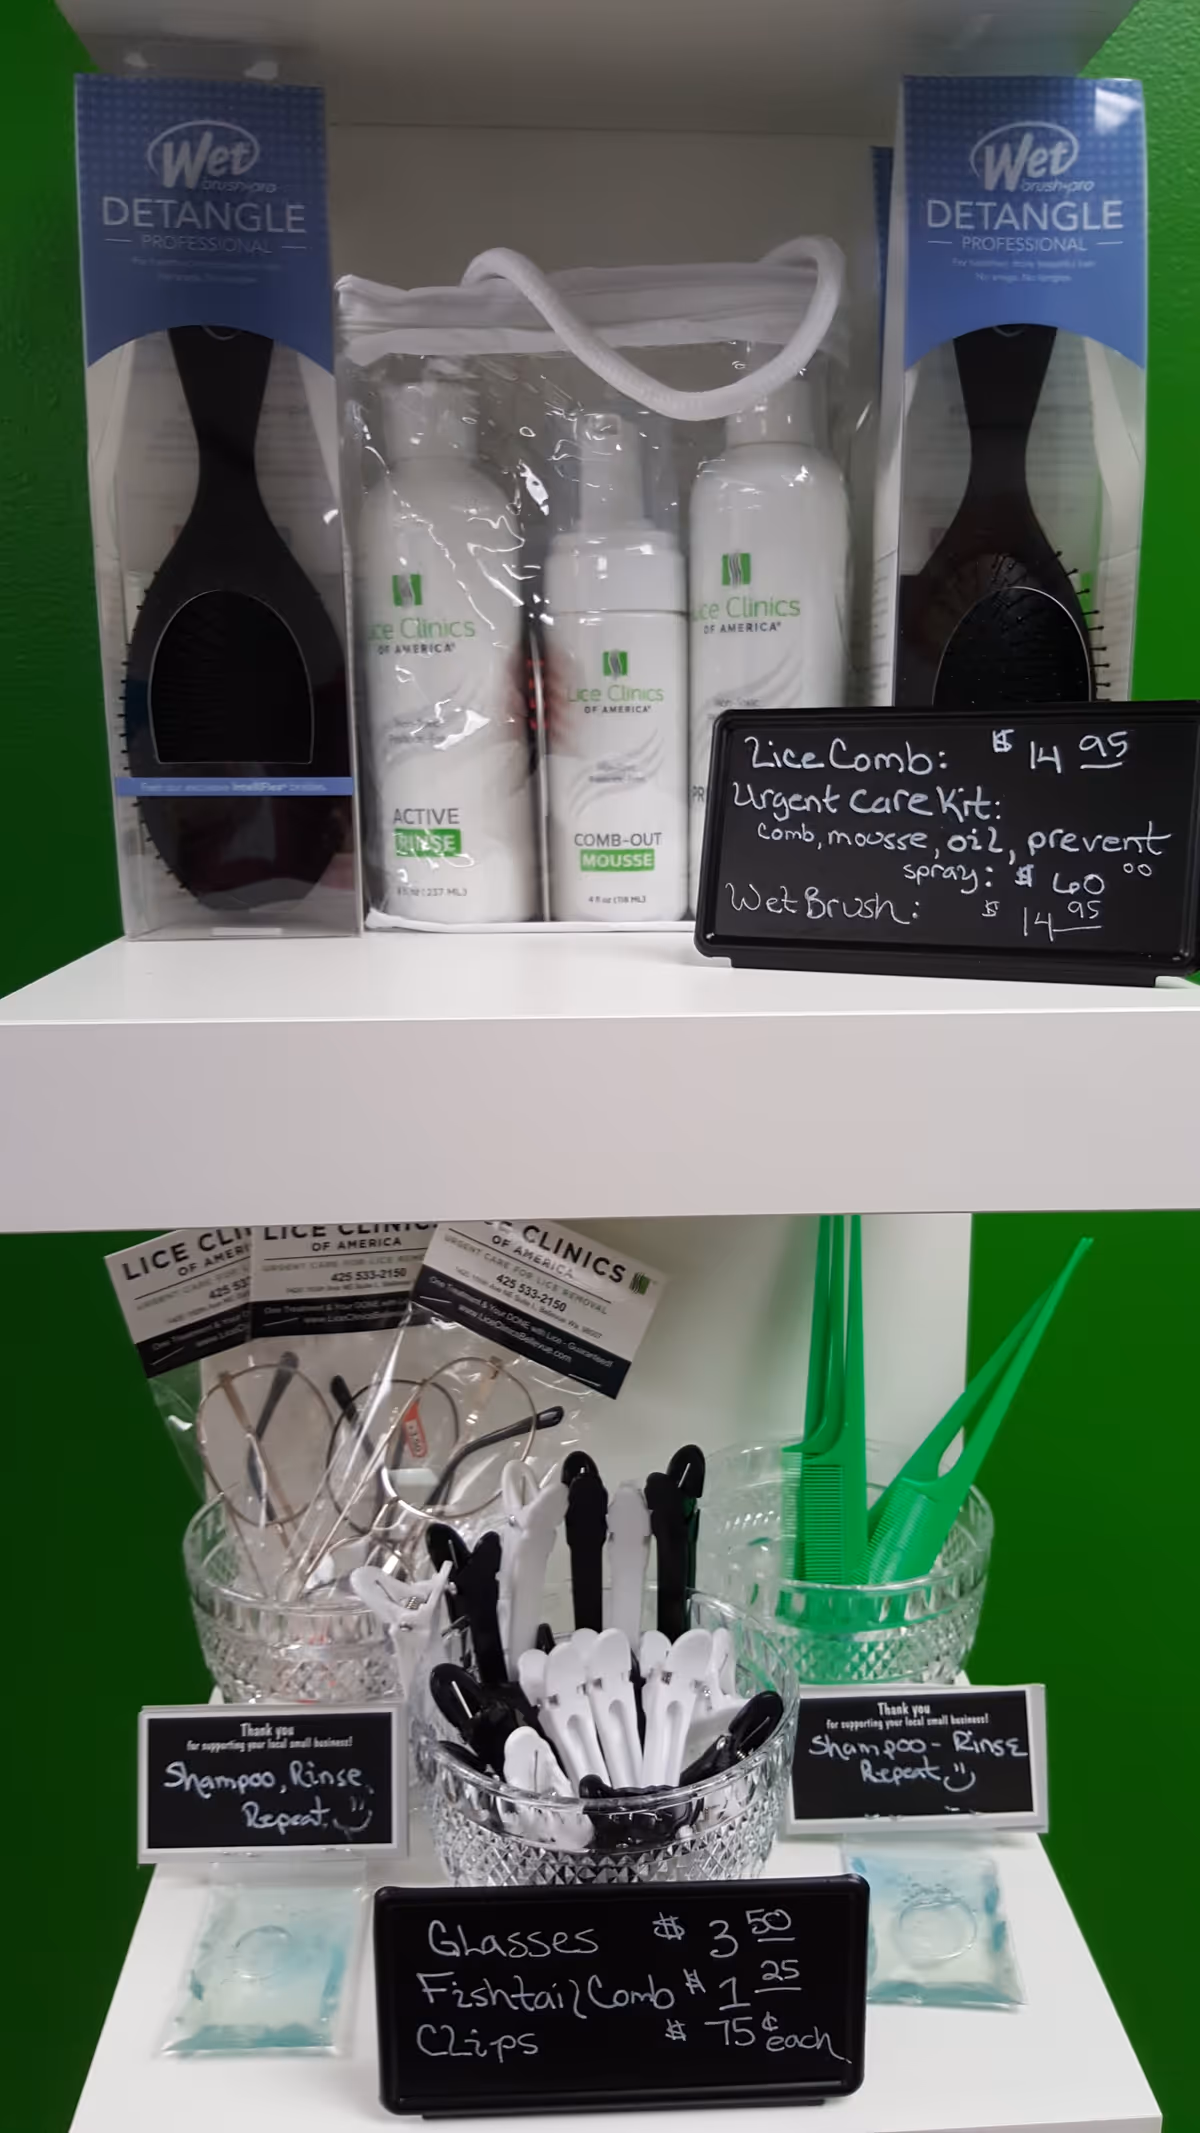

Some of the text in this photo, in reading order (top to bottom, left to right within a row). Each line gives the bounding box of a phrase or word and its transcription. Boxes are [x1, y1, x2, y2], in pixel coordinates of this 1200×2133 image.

[163, 131, 250, 189] Wet
[984, 132, 1069, 191] Wet
[102, 196, 307, 234] DETANGLE
[927, 199, 1124, 231] DETANGLE
[142, 234, 273, 254] PROFESSIONAL
[962, 235, 1088, 252] PROFESSIONAL
[726, 595, 801, 618] Clinics
[400, 616, 476, 639] Clinics
[703, 625, 716, 635] OF
[567, 683, 665, 702] Lice Clinics
[583, 705, 597, 714] OF
[744, 736, 825, 769] Lice
[829, 737, 948, 775] Comb:
[1030, 740, 1062, 774] 14
[1078, 730, 1128, 763] 95
[732, 781, 840, 822] Urgent
[936, 784, 1001, 823] Kit:
[393, 807, 460, 825] ACTIVE
[396, 834, 457, 852] RINSE
[574, 831, 663, 847] COMB-OUT
[827, 829, 940, 860] mousse,
[947, 826, 1016, 866] oil,
[1027, 820, 1173, 857] prevent
[581, 853, 654, 868] MOUSSE
[902, 863, 994, 895] spray:
[1052, 872, 1106, 895] 60
[1123, 862, 1153, 877] 00
[725, 882, 798, 914] Wet
[1022, 906, 1054, 942] 14
[1067, 899, 1103, 921] 95
[264, 1226, 327, 1241] LICE
[311, 1237, 402, 1252] OF AMERICA
[122, 1242, 190, 1281] LICE
[491, 1235, 511, 1247] OF
[513, 1245, 574, 1279] AMERICA
[523, 1225, 627, 1283] CLINICS
[177, 1262, 197, 1276] OF
[331, 1267, 407, 1283] 425 533-2150
[484, 1252, 511, 1270] CARE
[562, 1288, 607, 1315] REMOVAL
[496, 1274, 517, 1289] 425
[518, 1283, 567, 1312] 533-2150
[506, 1312, 531, 1329] DONE
[877, 1701, 931, 1718] Thank you
[240, 1722, 295, 1740] Thank you
[826, 1712, 989, 1731] for supporting your local small business!
[186, 1735, 353, 1753] for supporting your local small business!
[809, 1734, 927, 1761] Shampoo
[163, 1761, 287, 1799] Shampoo,
[652, 1911, 686, 1941] $
[708, 1919, 739, 1958] 3
[745, 1908, 792, 1938] 50
[416, 1971, 588, 2019] Fishtail
[588, 1974, 675, 2010] Comb
[718, 1976, 752, 2011] 1
[760, 1959, 801, 1984] 25
[766, 2026, 852, 2064] each
